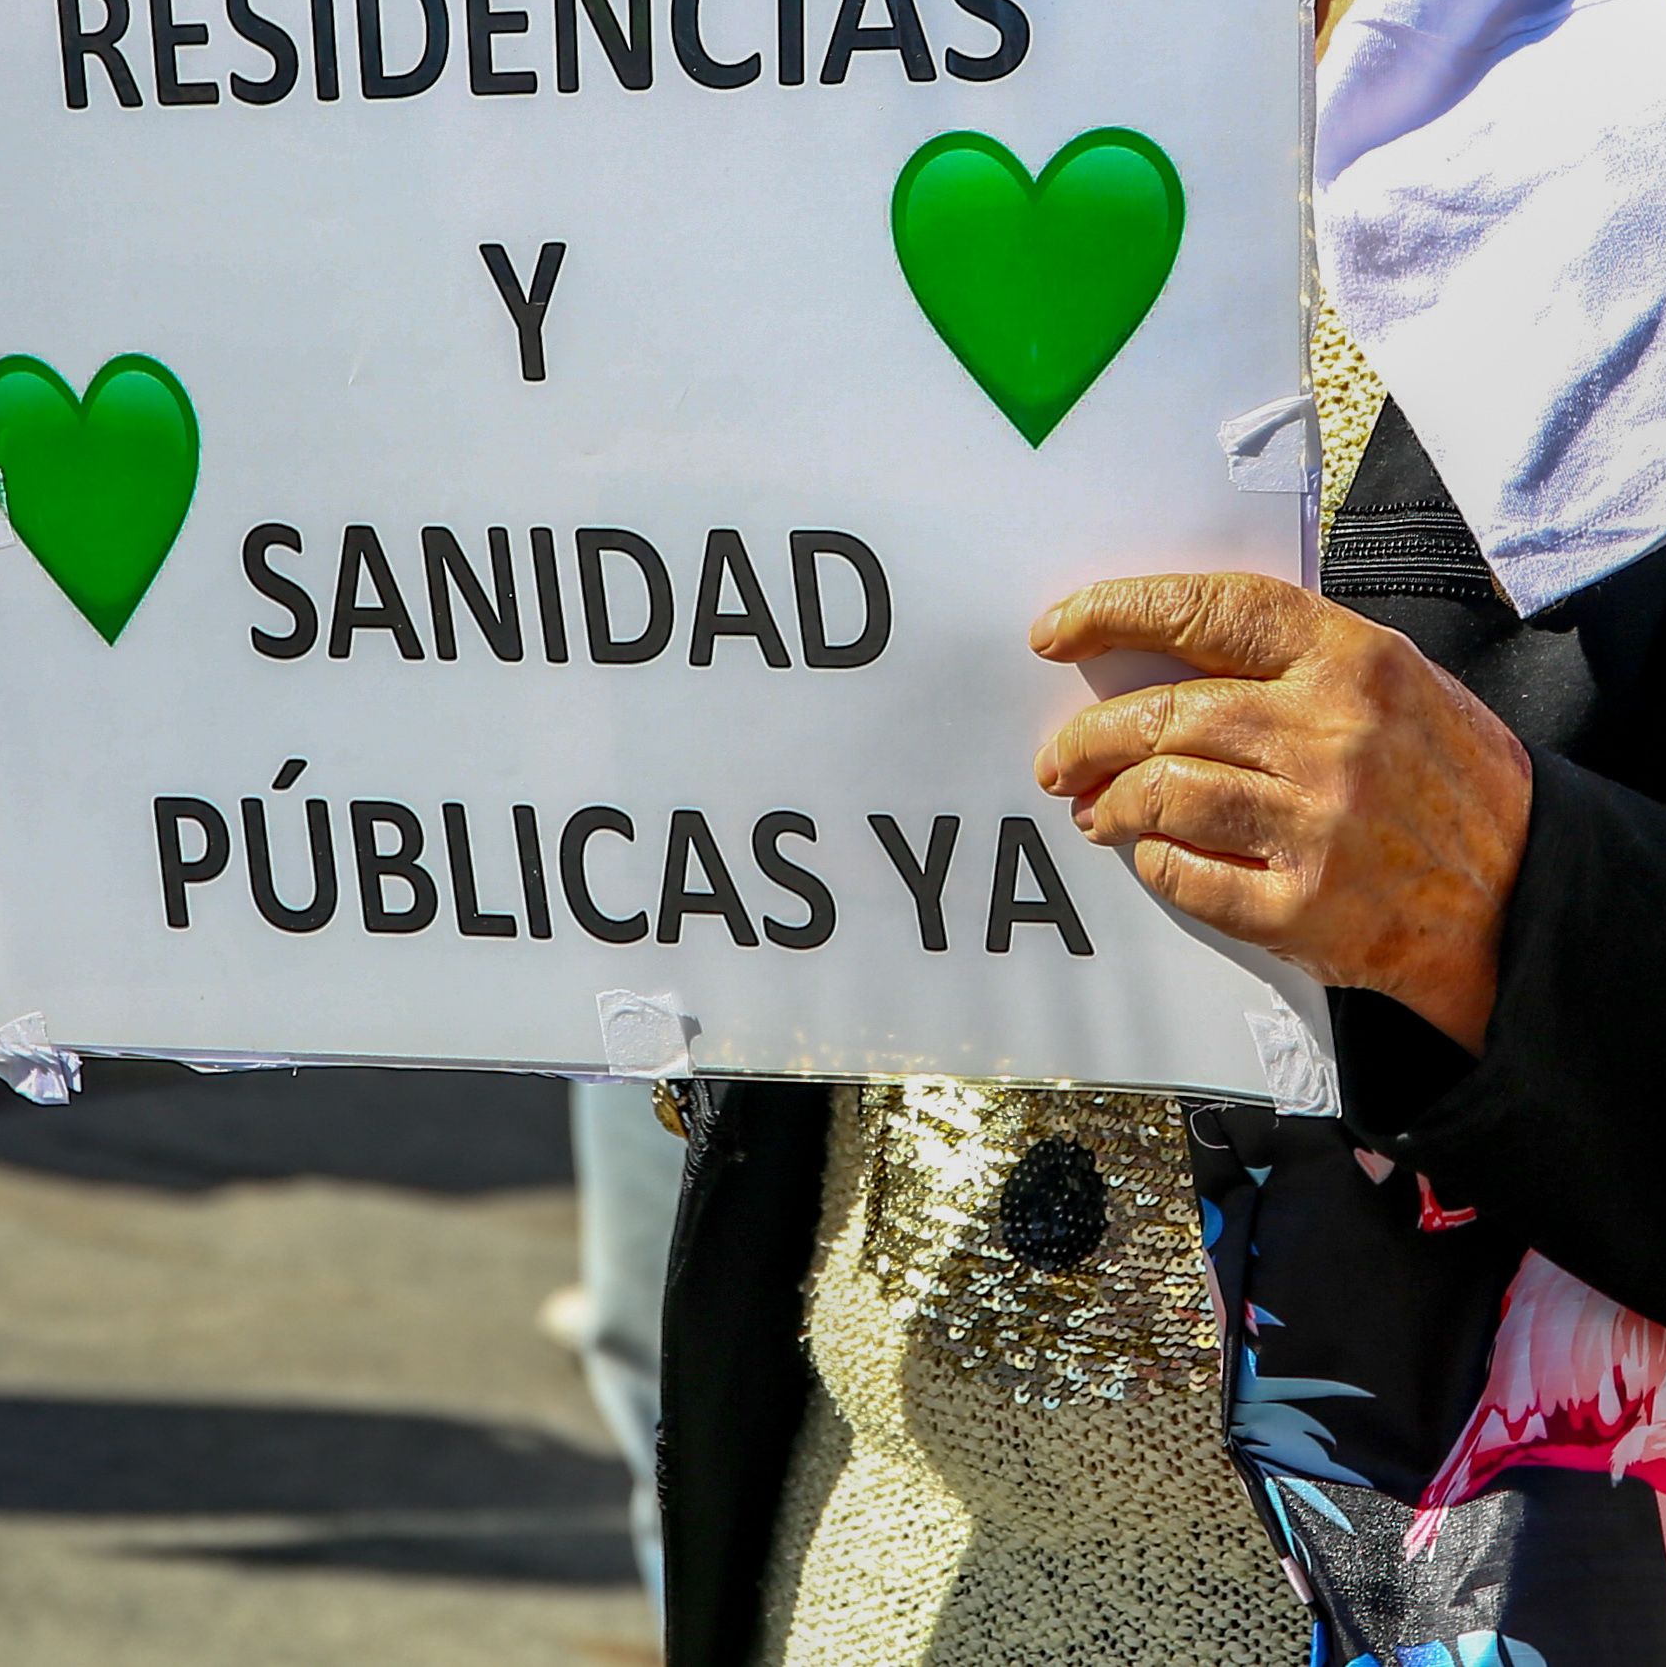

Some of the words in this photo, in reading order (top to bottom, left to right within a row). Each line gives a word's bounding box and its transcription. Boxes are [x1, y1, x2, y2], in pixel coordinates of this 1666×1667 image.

[478, 241, 567, 382] Y
[242, 522, 892, 670] SANIDAD
[153, 758, 837, 951] PÚBLICAS
[866, 814, 1095, 957] YA
